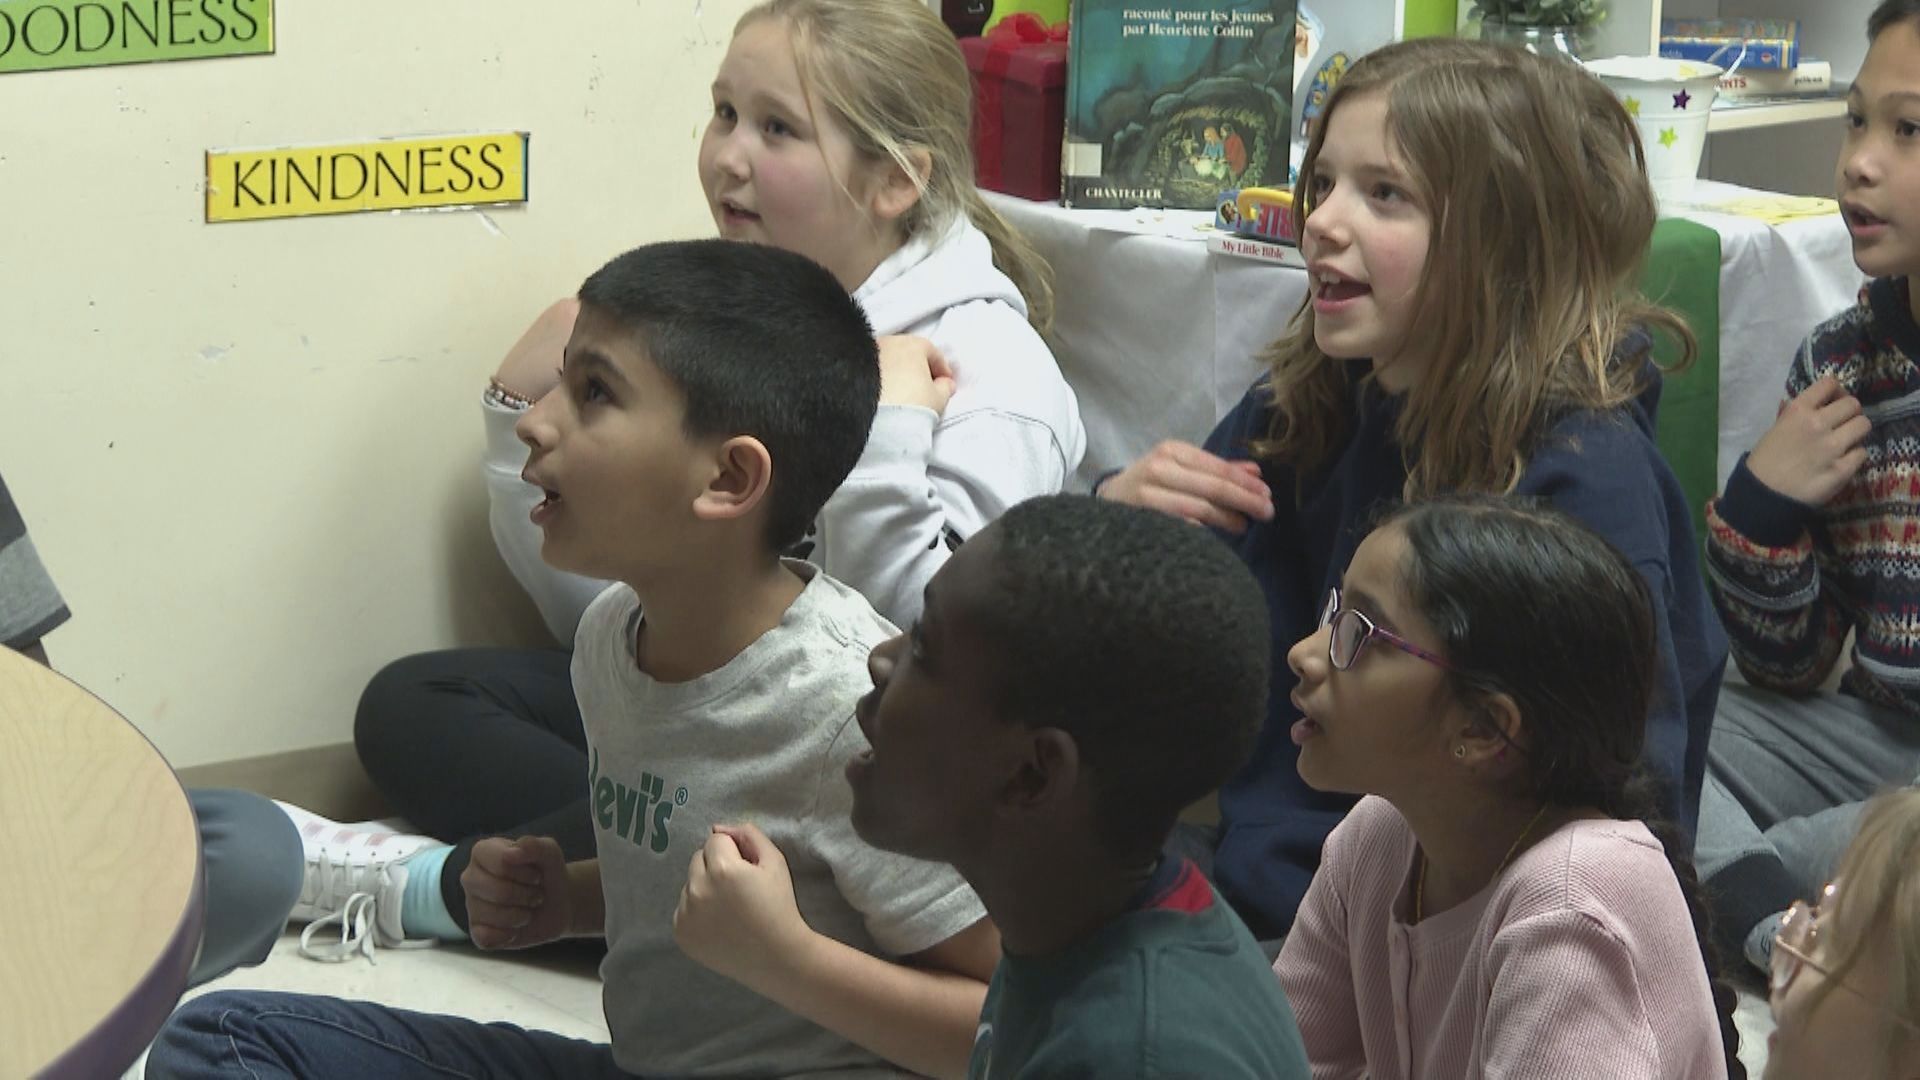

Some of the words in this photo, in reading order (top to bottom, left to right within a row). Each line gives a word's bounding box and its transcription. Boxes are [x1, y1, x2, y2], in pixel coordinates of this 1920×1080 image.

[1175, 10, 1208, 23] pour
[1211, 9, 1228, 21] les
[1230, 9, 1274, 24] jeunes
[1123, 24, 1145, 38] par
[1149, 23, 1210, 37] Henriette
[232, 142, 505, 208] KINDNESS
[1222, 240, 1235, 252] My
[1238, 243, 1260, 256] Little
[1262, 246, 1285, 260] Bible
